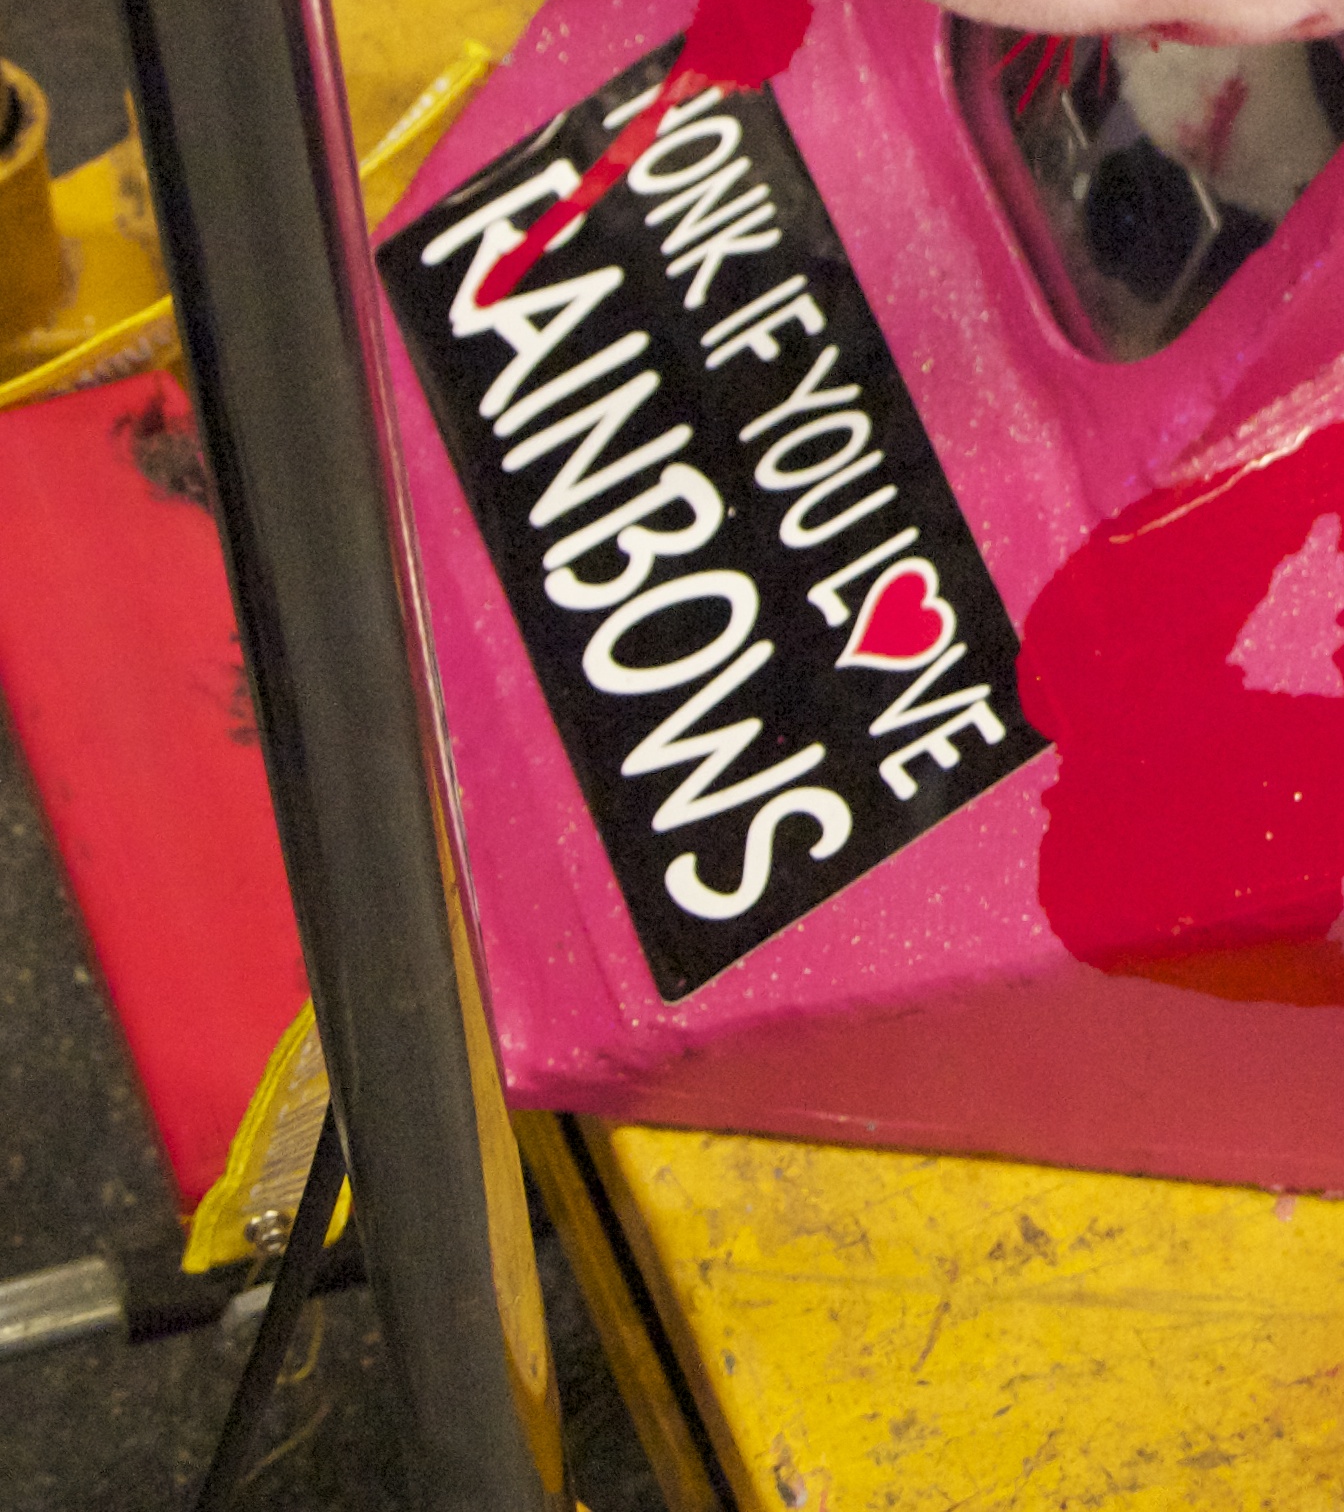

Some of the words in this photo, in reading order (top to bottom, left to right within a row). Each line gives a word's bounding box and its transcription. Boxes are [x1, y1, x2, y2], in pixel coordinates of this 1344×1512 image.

[699, 275, 825, 369] IF
[421, 157, 854, 921] RAINBOWS
[738, 345, 897, 549] YOU
